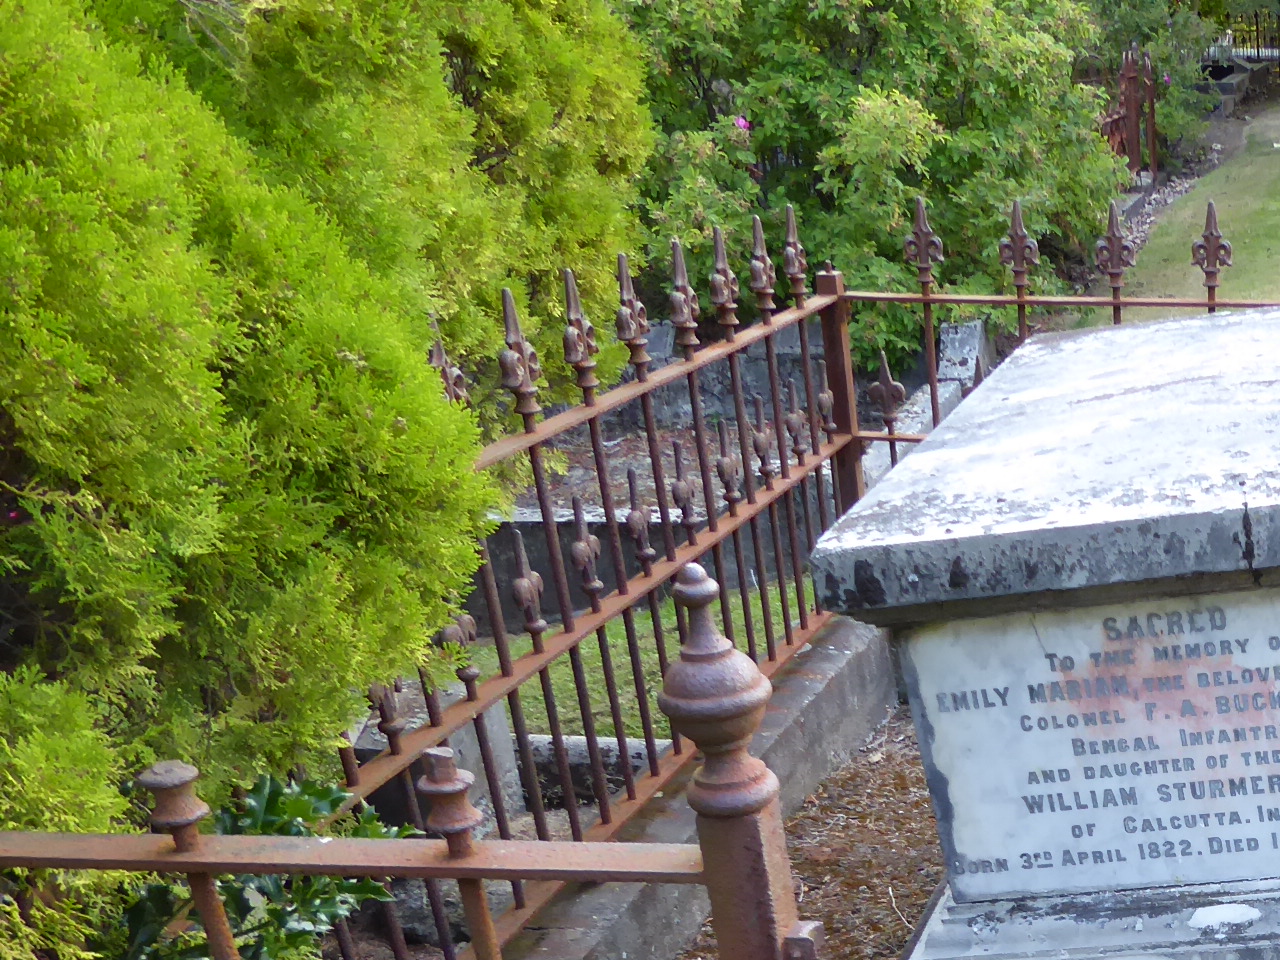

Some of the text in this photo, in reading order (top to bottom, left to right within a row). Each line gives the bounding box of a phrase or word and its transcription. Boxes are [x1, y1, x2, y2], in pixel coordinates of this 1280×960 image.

[1103, 606, 1227, 641] SACRED
[1045, 652, 1075, 672] TO
[1090, 648, 1135, 668] THE
[1154, 638, 1249, 662] MEMORY
[937, 686, 1010, 713] EMILY
[1143, 674, 1185, 692] THE
[1020, 709, 1126, 732] COLONEL
[1072, 735, 1160, 756] BENGAL
[1027, 768, 1071, 785] AND
[1084, 757, 1196, 780] DAUGHTER
[1206, 754, 1229, 770] OF
[1021, 786, 1138, 814] WILLIAM
[1071, 822, 1096, 838] OF
[1123, 810, 1251, 834] CALCUTTA.
[952, 857, 1010, 875] BORN
[1061, 848, 1128, 867] APRIL
[1137, 839, 1203, 860] 1822.
[1208, 836, 1260, 855] DIED
